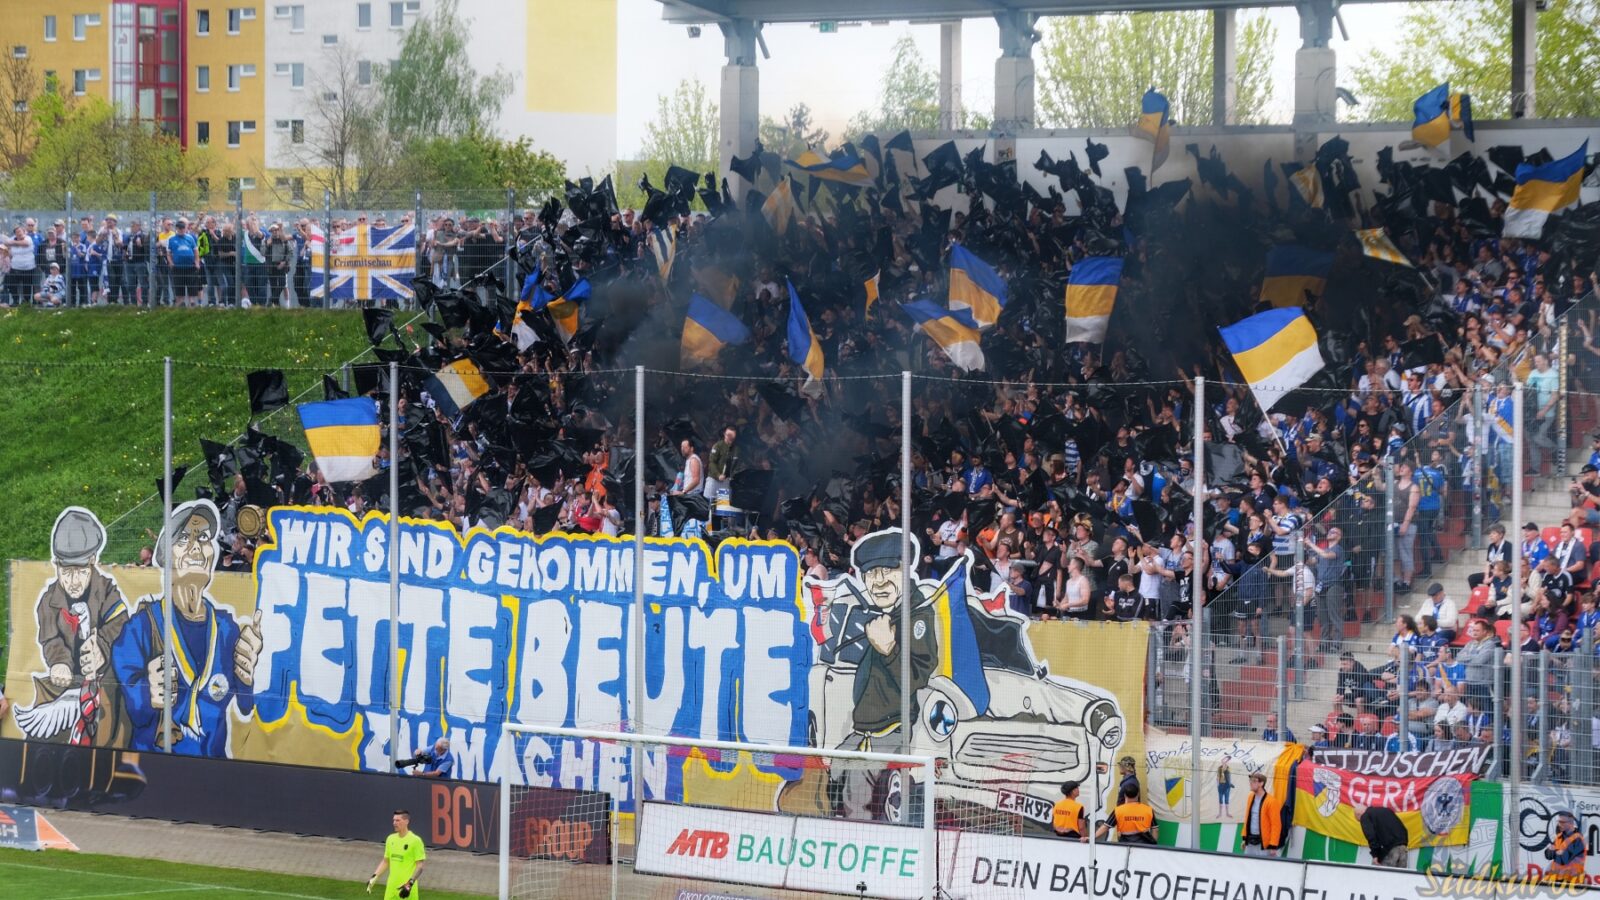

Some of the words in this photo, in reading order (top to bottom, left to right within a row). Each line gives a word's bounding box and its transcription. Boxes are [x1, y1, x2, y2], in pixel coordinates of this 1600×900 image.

[333, 257, 392, 267] Crimmitschau
[280, 518, 351, 567] WIR
[363, 526, 454, 579] SND
[468, 541, 711, 606] GEKOMMEN,
[724, 552, 786, 600] UM
[252, 561, 495, 722] FETTE
[516, 599, 796, 746] BEUTE
[1347, 778, 1419, 812] GERA
[524, 816, 594, 859] GROUP
[666, 828, 730, 859] MTB
[735, 833, 919, 877] BAUSTOFFE
[971, 856, 1041, 889] DEIN
